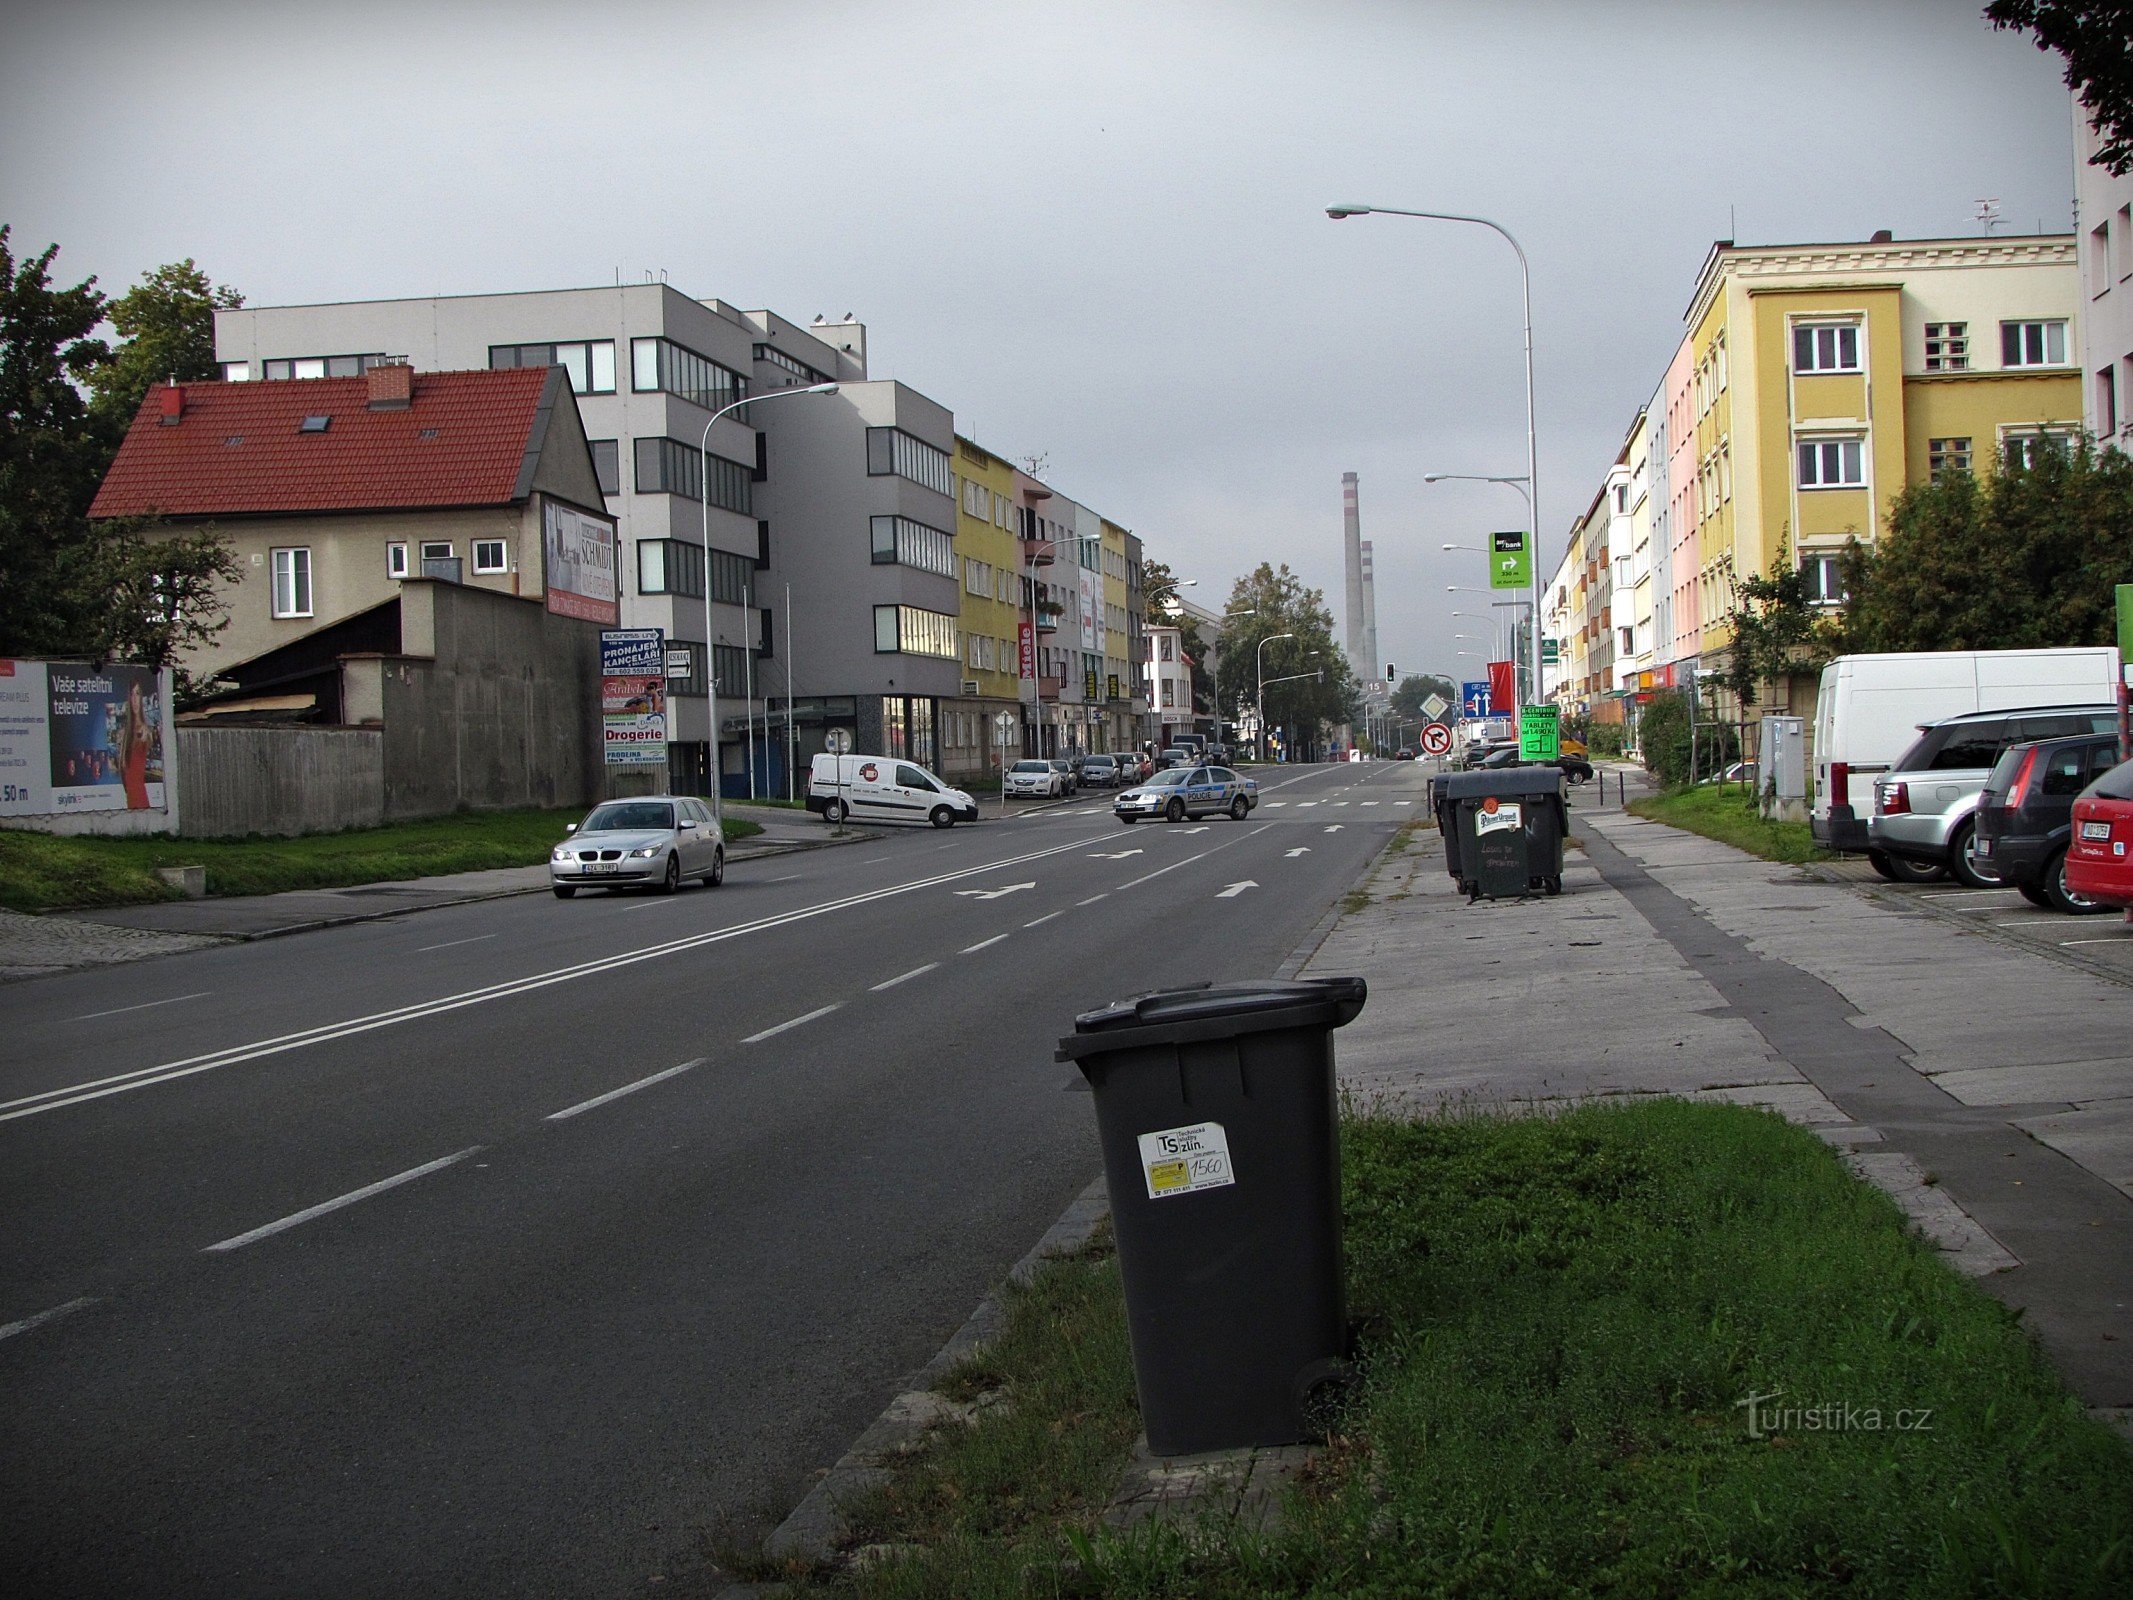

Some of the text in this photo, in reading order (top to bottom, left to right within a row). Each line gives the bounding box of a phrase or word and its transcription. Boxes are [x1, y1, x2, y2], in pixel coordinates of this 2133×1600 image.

[581, 539, 612, 571] SCHMIDT
[604, 640, 658, 659] PRONÁJEM
[604, 648, 660, 668] KANCELÁŘÍ
[1021, 627, 1032, 681] Miele
[52, 675, 113, 694] Vaše satelitní
[1368, 682, 1380, 691] 15
[53, 698, 89, 715] televize
[605, 729, 663, 742] Drogerie
[4, 785, 29, 802] 50 m
[1187, 792, 1212, 800] POLICIE
[1158, 1135, 1179, 1153] TS
[1191, 1158, 1222, 1178] 1560
